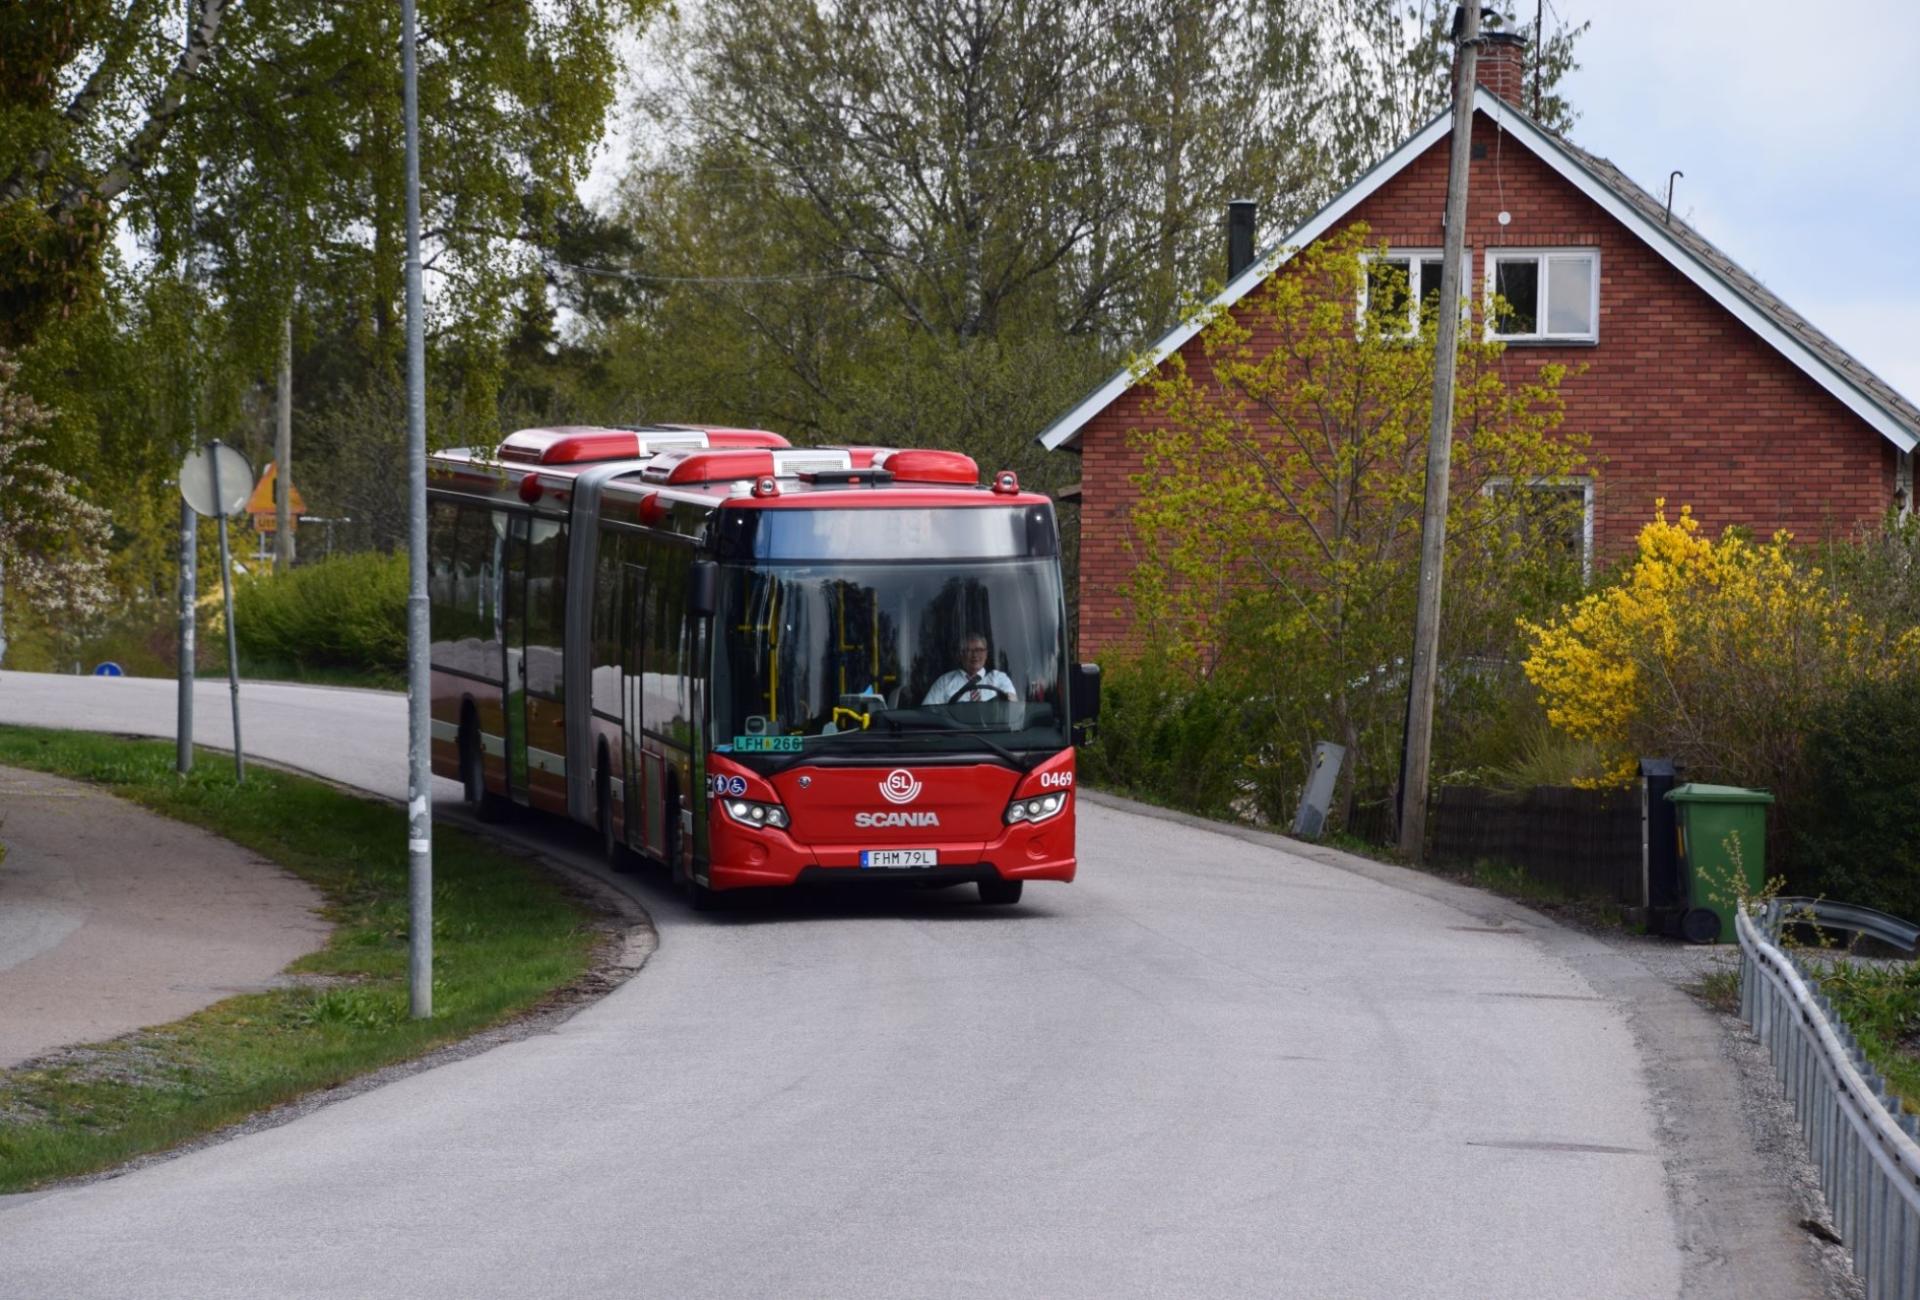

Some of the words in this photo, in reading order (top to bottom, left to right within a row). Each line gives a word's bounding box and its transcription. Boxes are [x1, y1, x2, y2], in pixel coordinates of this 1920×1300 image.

[735, 737, 763, 750] LFH
[773, 737, 801, 750] 266
[891, 776, 910, 789] SL
[1040, 771, 1072, 787] 0469
[854, 812, 940, 828] SCANIA
[873, 852, 900, 864] FHM
[904, 851, 930, 864] 79L
